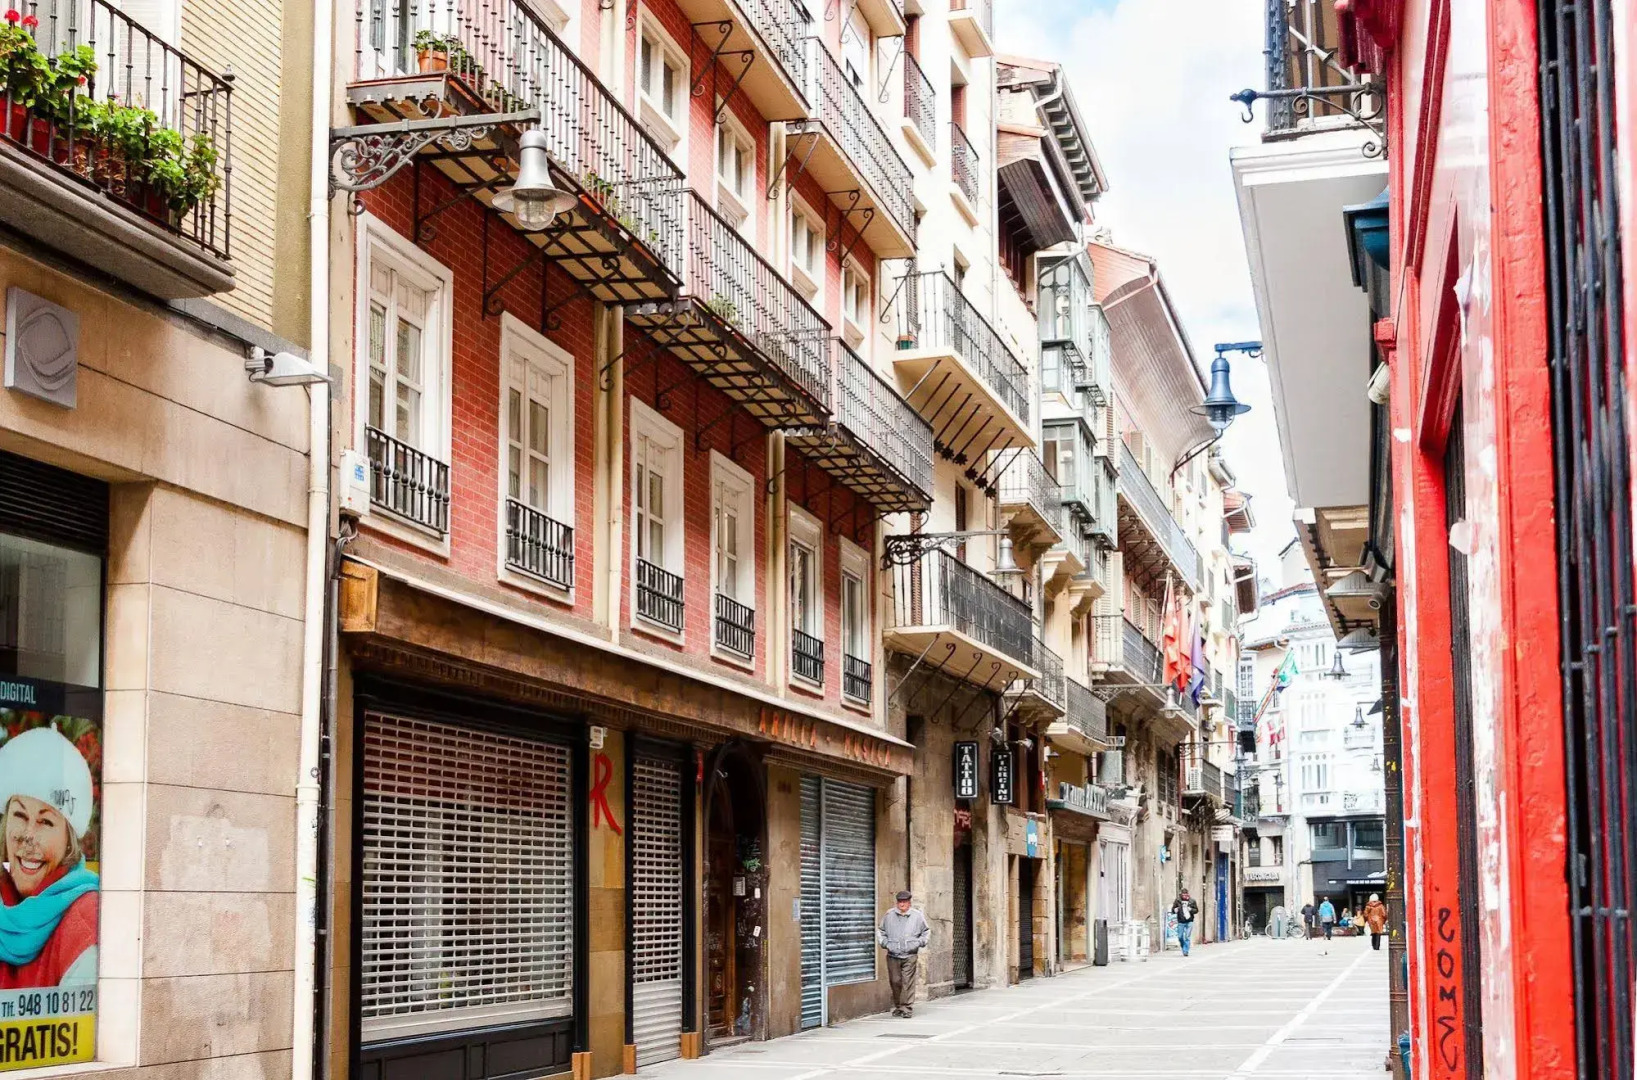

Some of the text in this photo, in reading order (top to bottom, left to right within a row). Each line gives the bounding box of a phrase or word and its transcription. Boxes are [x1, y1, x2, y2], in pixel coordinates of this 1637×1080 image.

[0, 681, 36, 705] DIGITAL
[961, 746, 972, 795] TATTOO
[998, 754, 1008, 800] PIERCING
[589, 752, 622, 836] R
[1, 989, 94, 1018] Tlf. 948 10 81 22
